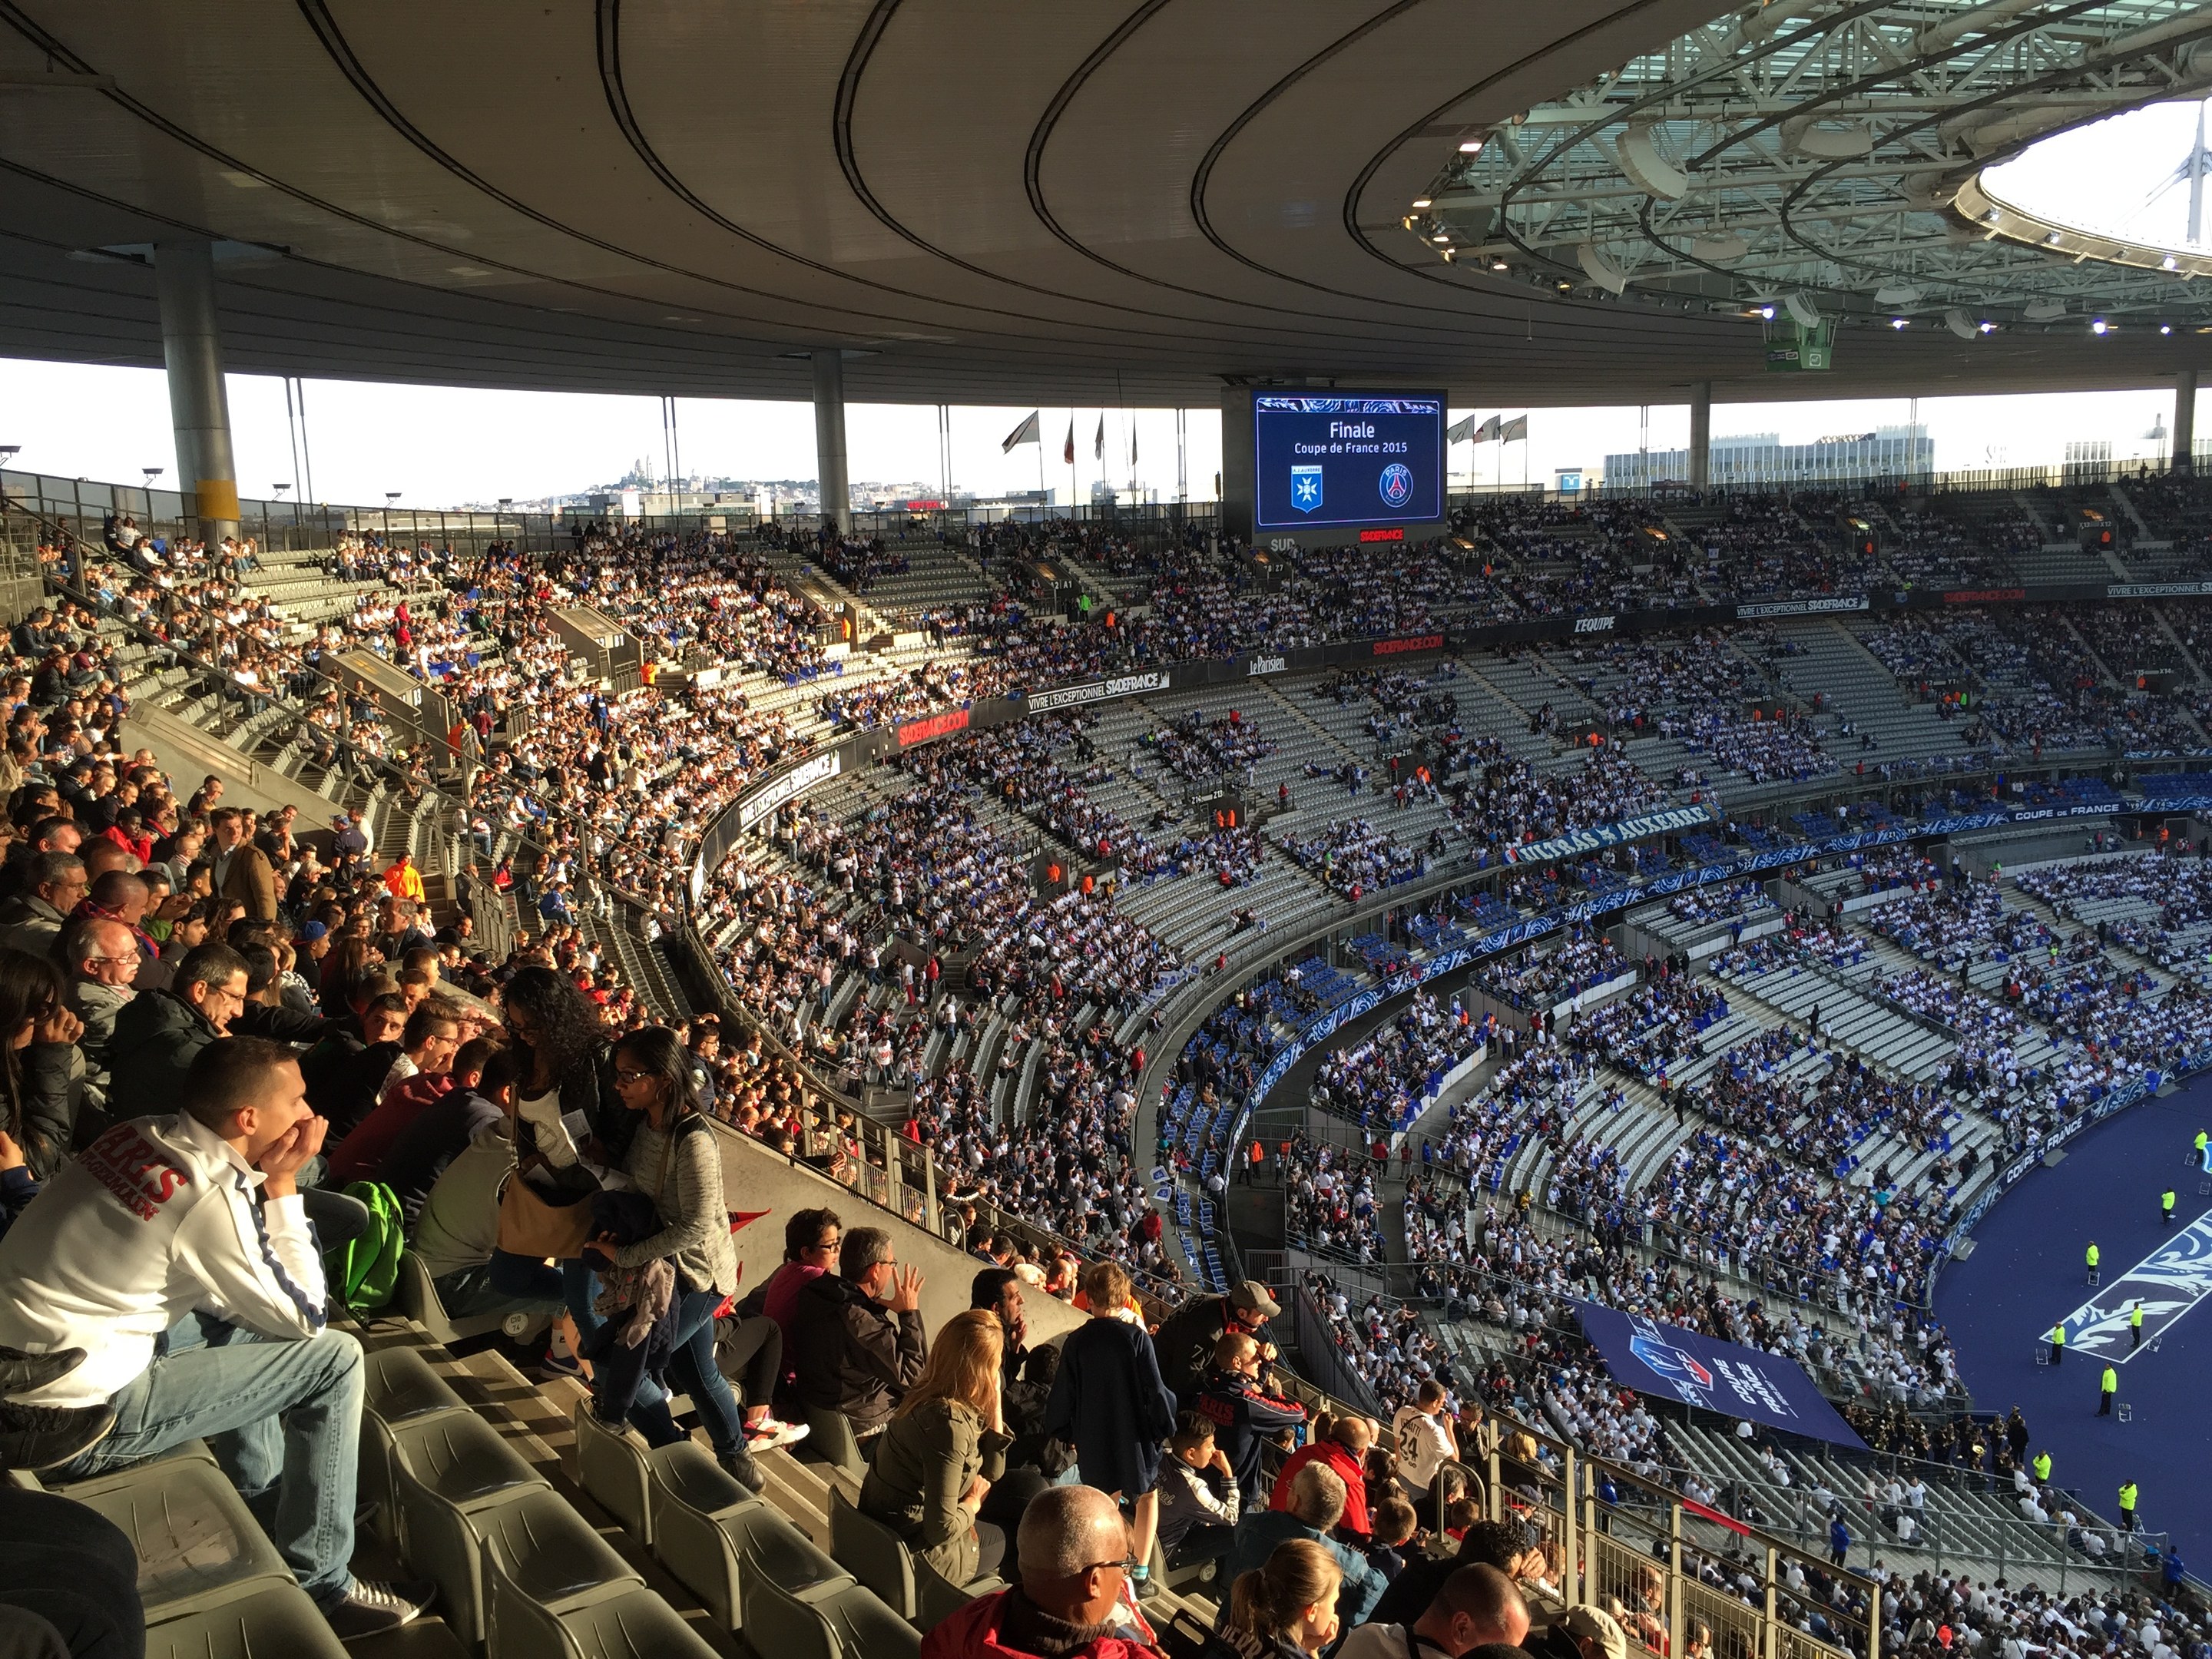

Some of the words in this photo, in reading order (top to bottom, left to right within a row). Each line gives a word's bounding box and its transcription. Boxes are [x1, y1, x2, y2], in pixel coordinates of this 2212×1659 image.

[1330, 421, 1375, 439] Finale
[1294, 442, 1326, 455] Coupe
[1330, 442, 1343, 453] de
[1346, 442, 1379, 453] France
[1382, 442, 1408, 453] 2015
[1385, 466, 1408, 477] PARIS
[1063, 580, 1072, 589] A1
[2107, 586, 2131, 596] VIVRE
[2133, 584, 2200, 595] L'EXCEPTIONNEL
[1737, 607, 1756, 617] VIVRE
[1756, 603, 1807, 615] L'EXCEPTIONNEL
[1257, 655, 1285, 674] Parisien
[1028, 696, 1049, 711] VIVRE
[1049, 686, 1105, 707] L'EXCEPTIONNEL
[2015, 809, 2054, 821] COUPE
[2071, 803, 2120, 816] FRANCE
[1520, 831, 1600, 862] ULTRAS
[1617, 806, 1710, 841] AUXERRE
[2006, 1151, 2035, 1184] COUPE
[2047, 1116, 2083, 1151] FRANCE
[1675, 1351, 1707, 1385] FFF
[1712, 1357, 1757, 1406] COUPE
[1736, 1361, 1788, 1416] FRANCE
[1741, 1378, 1755, 1392] DE
[1399, 1431, 1419, 1462] 24
